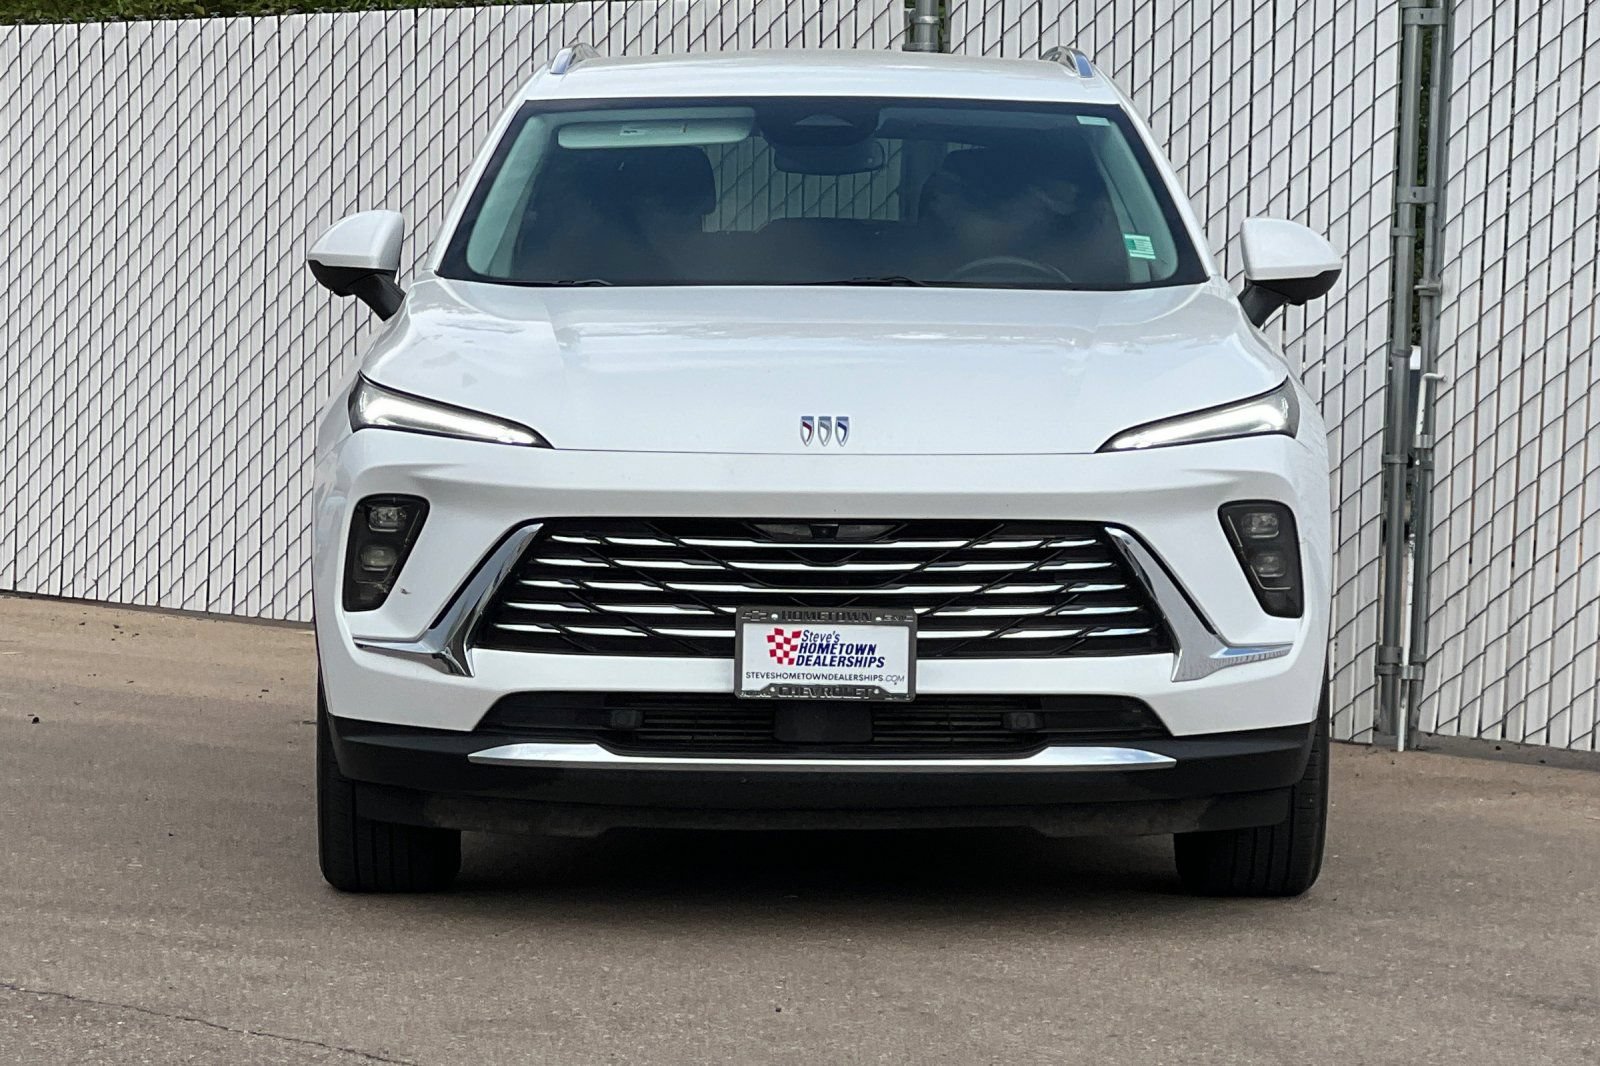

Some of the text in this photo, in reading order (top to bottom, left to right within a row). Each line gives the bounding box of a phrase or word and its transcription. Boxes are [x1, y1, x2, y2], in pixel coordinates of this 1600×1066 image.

[782, 610, 872, 623] HOMETOWN
[801, 629, 841, 643] Steve's
[798, 642, 877, 655] HOMETOWN
[795, 654, 885, 668] DEALERSHIPS
[745, 671, 905, 683] STEVESHOMETOWNDEALERSHIPS.COM
[778, 686, 870, 699] CHEVROLET
